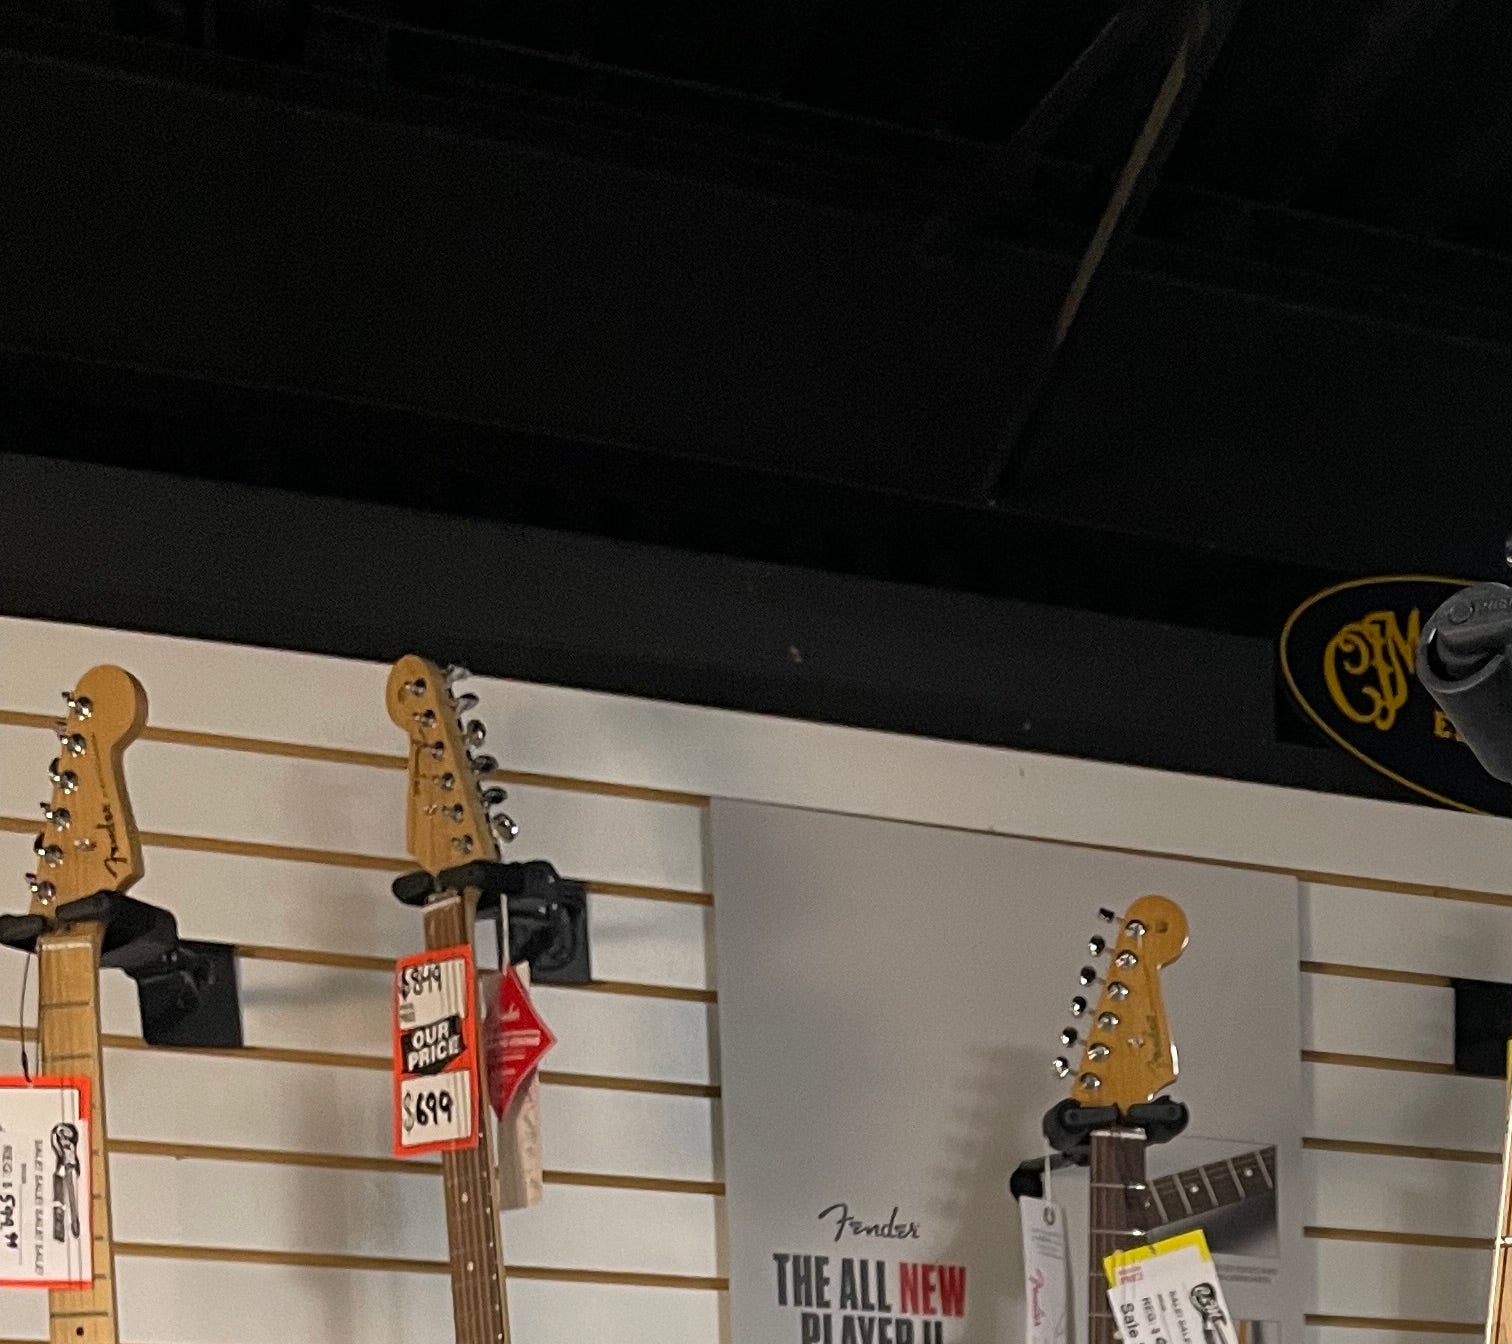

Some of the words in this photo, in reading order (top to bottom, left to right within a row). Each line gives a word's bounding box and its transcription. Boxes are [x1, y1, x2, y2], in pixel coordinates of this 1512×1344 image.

[412, 1021, 450, 1048] OUR
[403, 1091, 453, 1134] $699
[818, 1203, 921, 1242] Fender
[773, 1253, 831, 1309] THE
[840, 1257, 892, 1313] ALL
[899, 1262, 967, 1318] NEW
[1120, 1303, 1139, 1339] Sale
